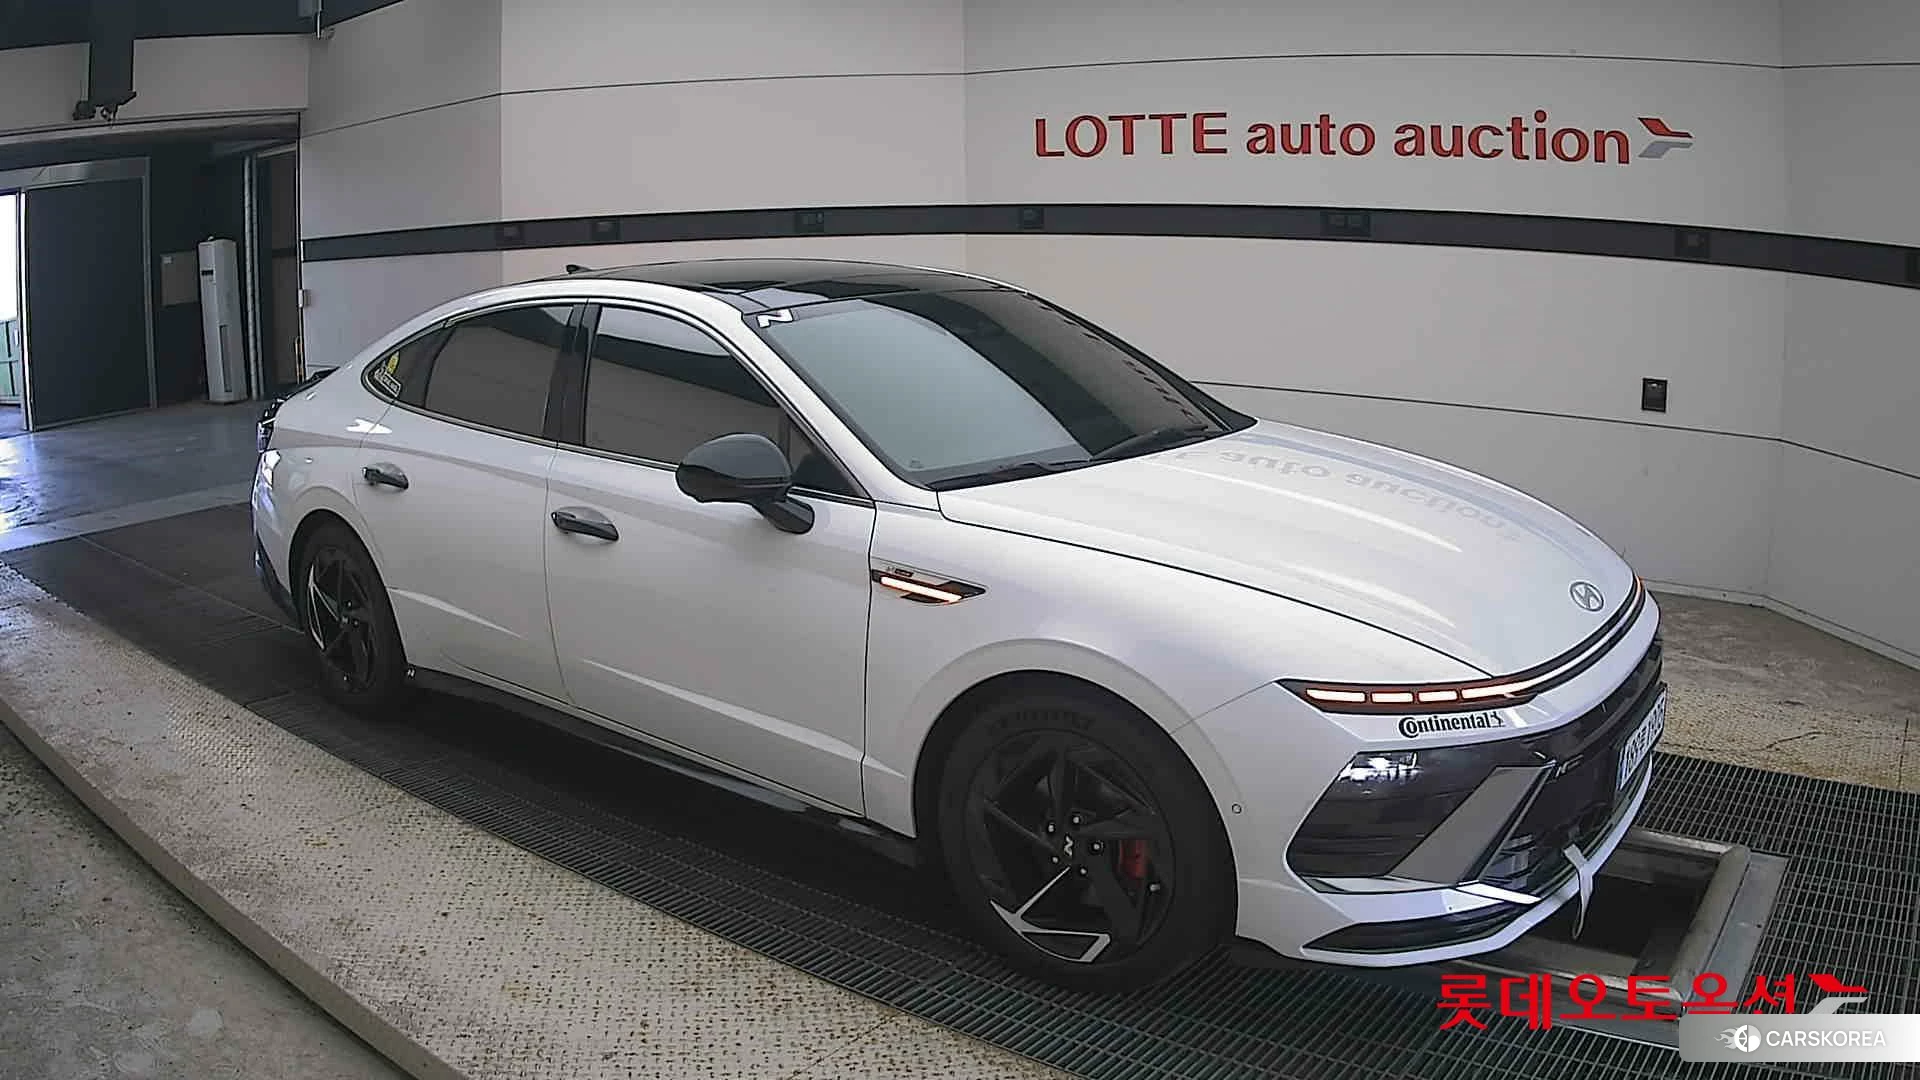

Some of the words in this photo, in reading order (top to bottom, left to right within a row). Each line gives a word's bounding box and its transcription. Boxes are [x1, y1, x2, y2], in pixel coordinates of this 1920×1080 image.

[1036, 112, 1228, 157] LOTTE
[1246, 113, 1376, 156] auto
[1394, 109, 1631, 164] auction
[1398, 711, 1491, 738] Continental
